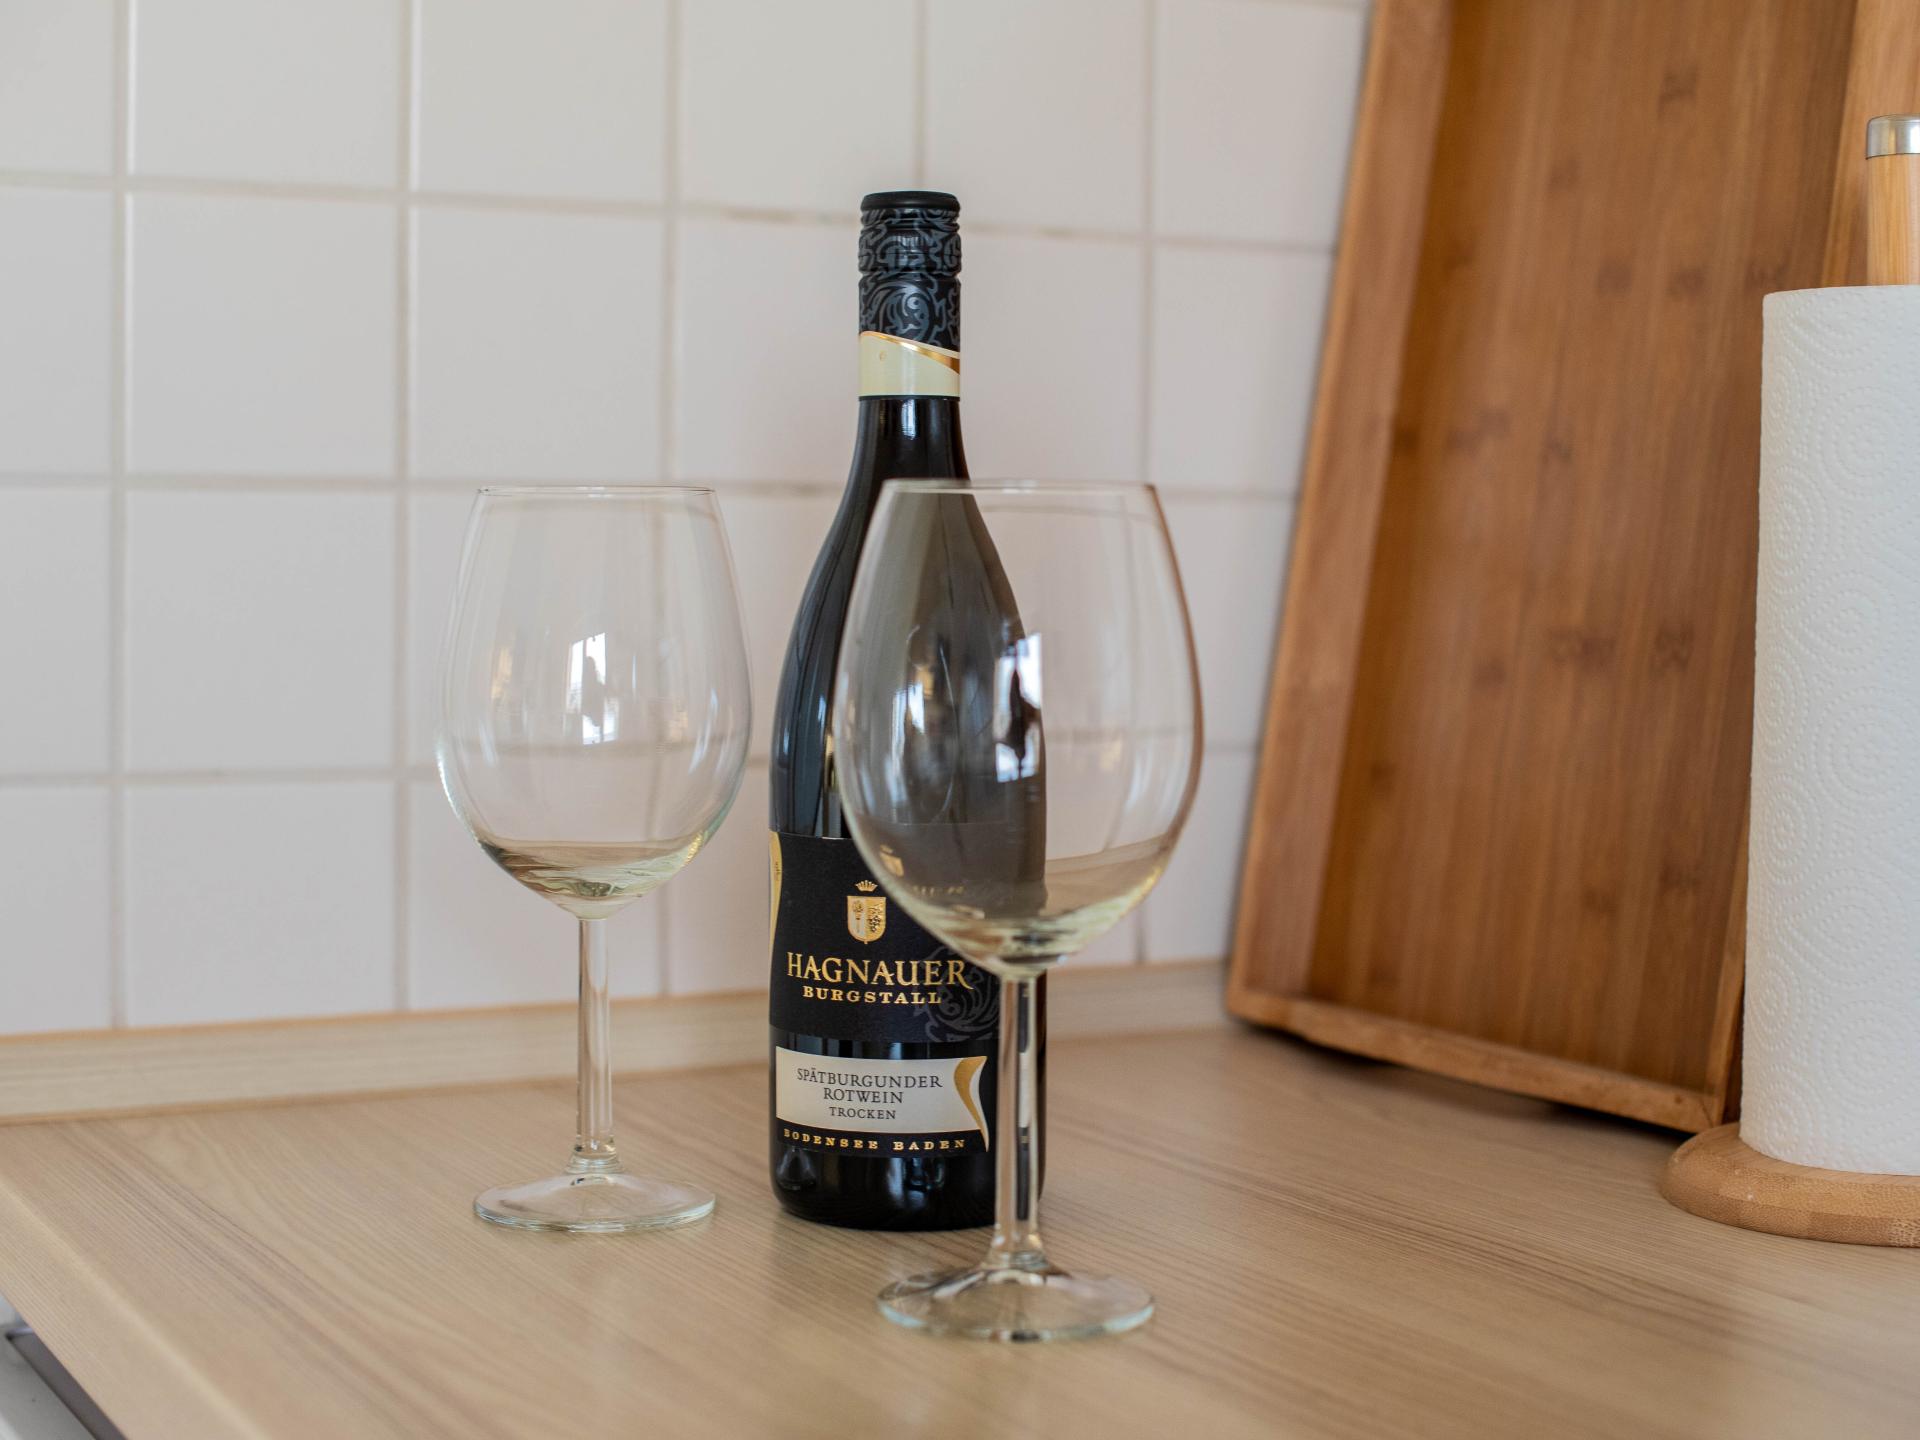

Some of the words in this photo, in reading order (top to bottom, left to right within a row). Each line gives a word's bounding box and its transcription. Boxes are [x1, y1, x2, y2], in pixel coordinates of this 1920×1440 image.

[786, 952, 975, 990] HAGNAUER
[802, 985, 942, 1004] BURGSTALL
[796, 1067, 943, 1088] SPÄTBURGUNDER
[823, 1087, 904, 1104] ROTWEIN
[828, 1106, 897, 1120] TROCKEN
[782, 1128, 878, 1150] BODENSEE
[892, 1139, 965, 1151] BADEN
